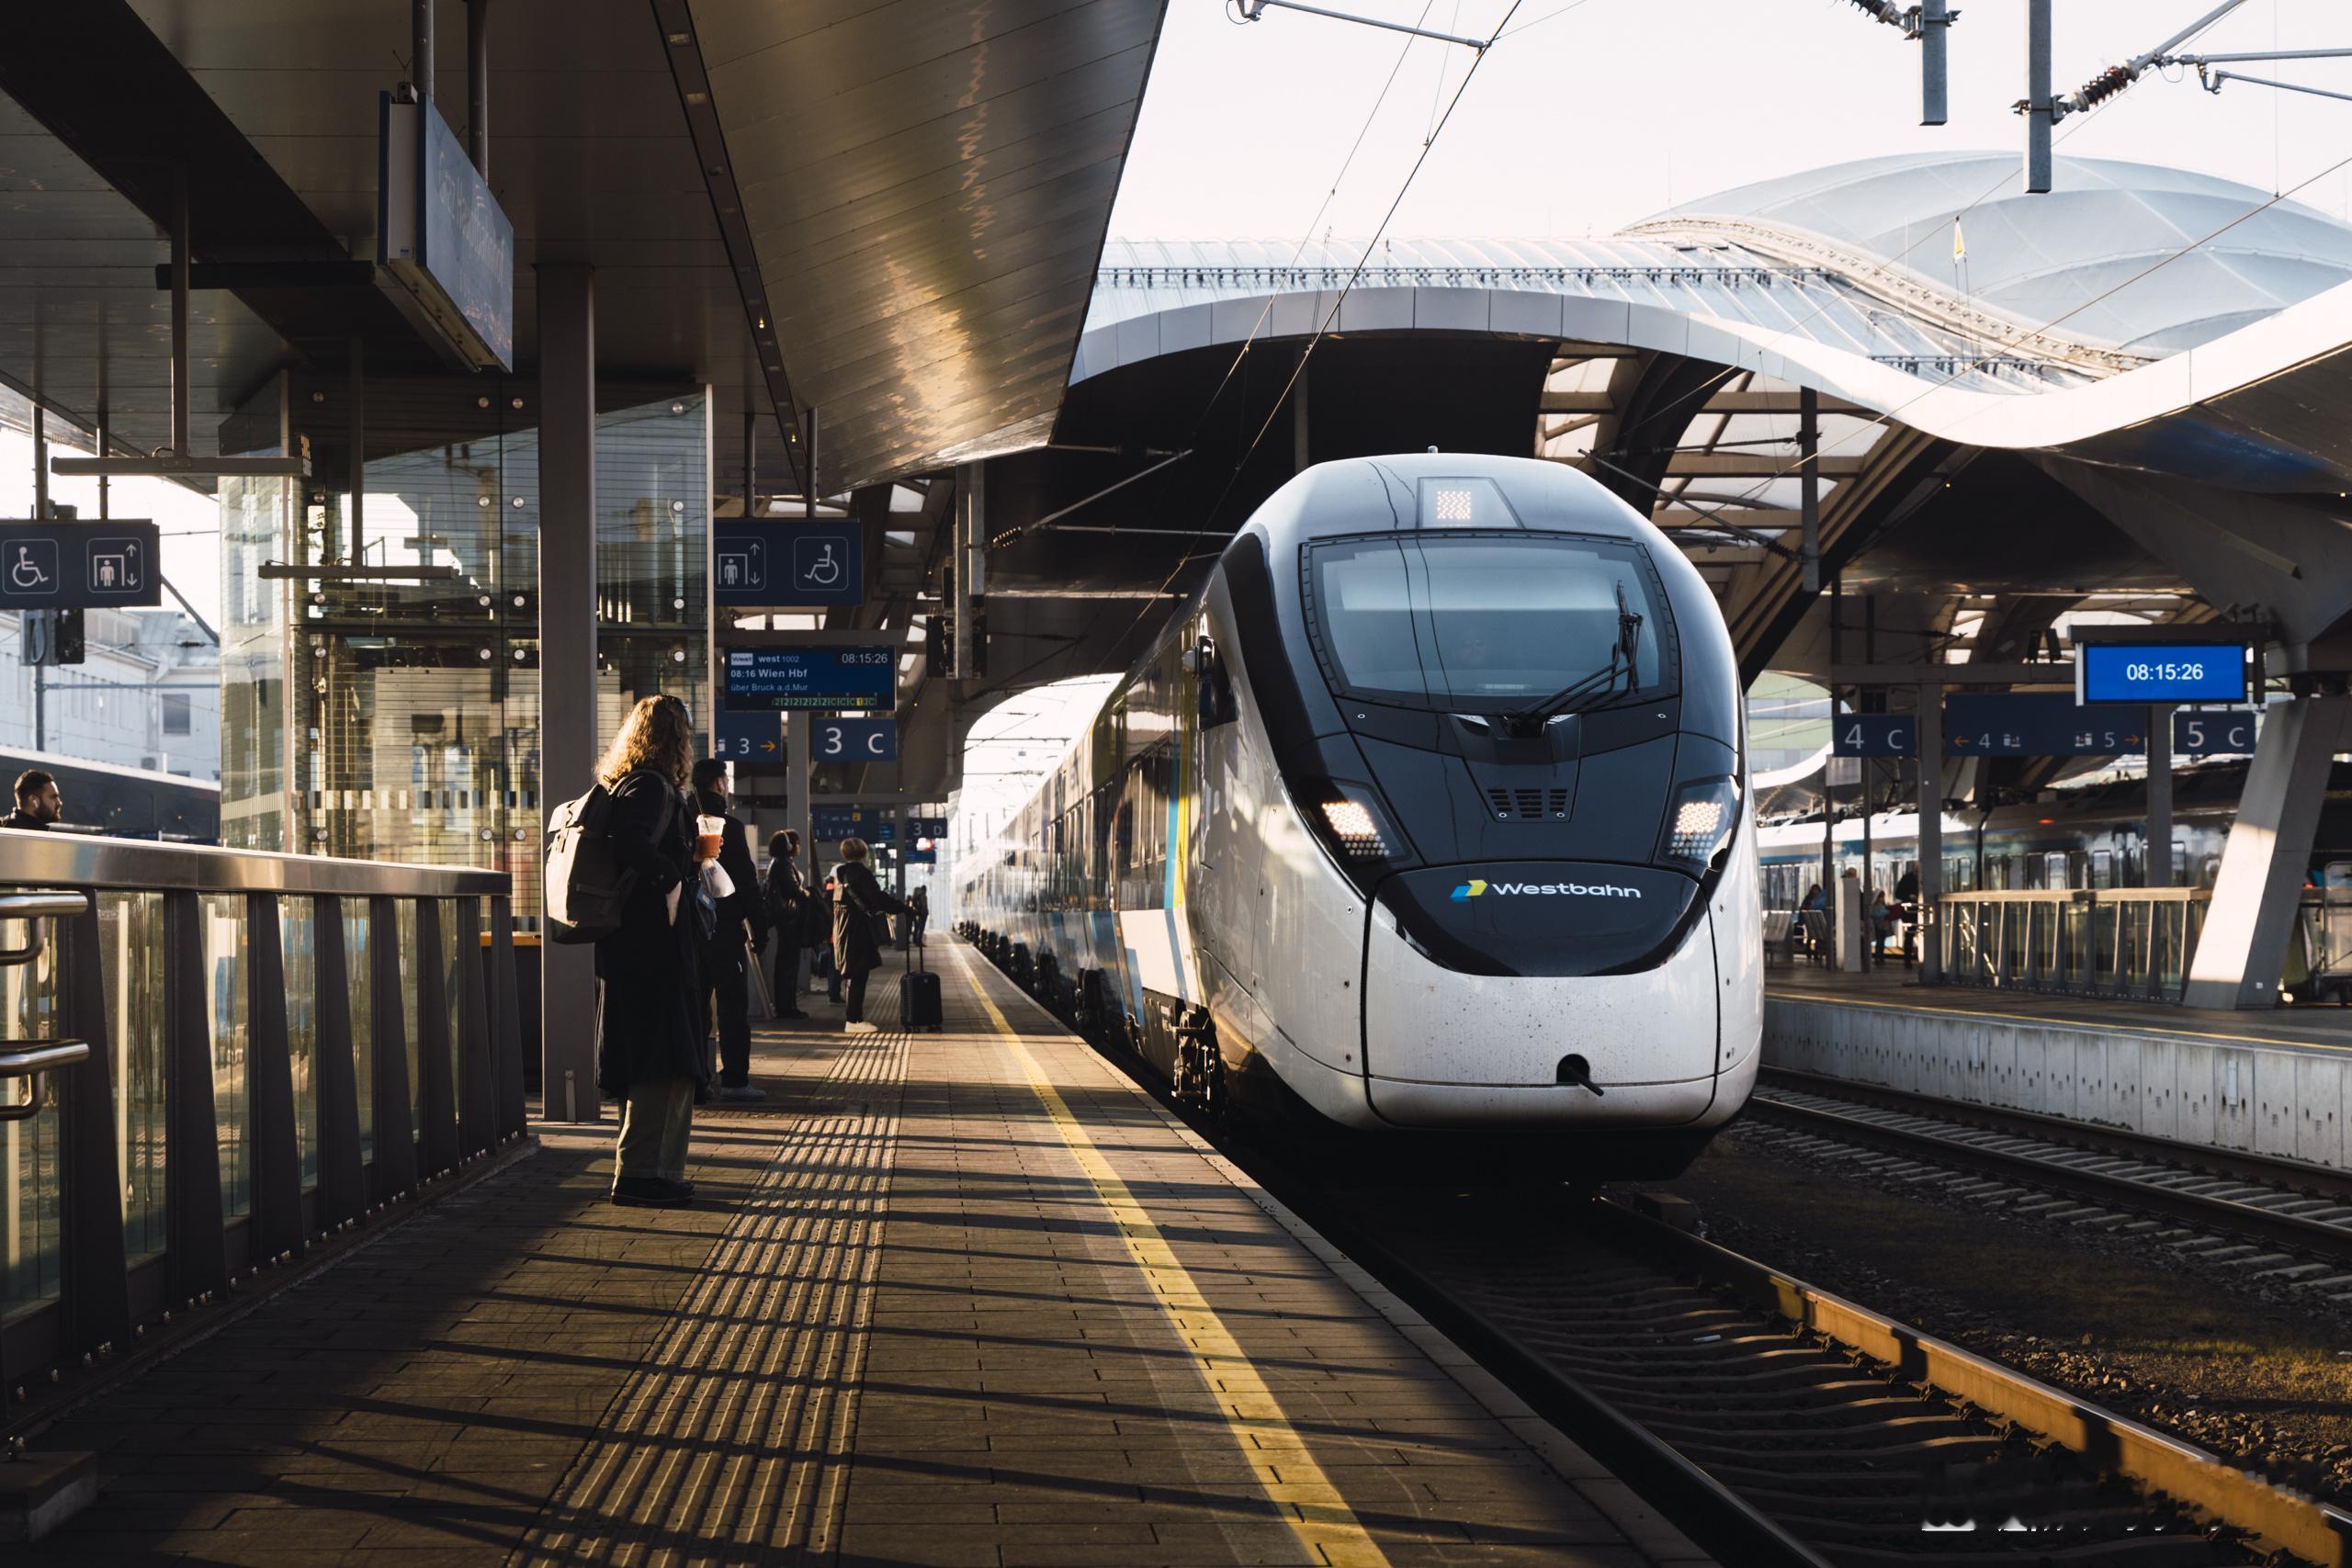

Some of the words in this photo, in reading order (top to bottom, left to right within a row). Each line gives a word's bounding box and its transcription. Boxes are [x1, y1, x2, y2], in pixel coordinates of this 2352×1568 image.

[758, 655, 781, 663] west
[782, 655, 800, 663] 1002
[842, 653, 888, 663] 08:15:26
[730, 670, 756, 678] 08:16
[758, 669, 786, 678] Wien
[788, 669, 808, 678] Hbf
[2126, 660, 2204, 681] 08:15:26
[730, 682, 750, 692] über
[752, 682, 775, 692] Bruck
[825, 727, 842, 754] 3
[867, 733, 884, 753] C
[1844, 723, 1865, 750] 4
[1887, 728, 1904, 750] C
[1978, 733, 1992, 749] 4
[2104, 732, 2115, 748] 5
[2187, 721, 2205, 748] 5
[2228, 728, 2245, 747] C
[739, 738, 750, 754] 3
[913, 822, 922, 837] 3
[933, 826, 943, 836] D
[1491, 883, 1642, 898] Westbahn
